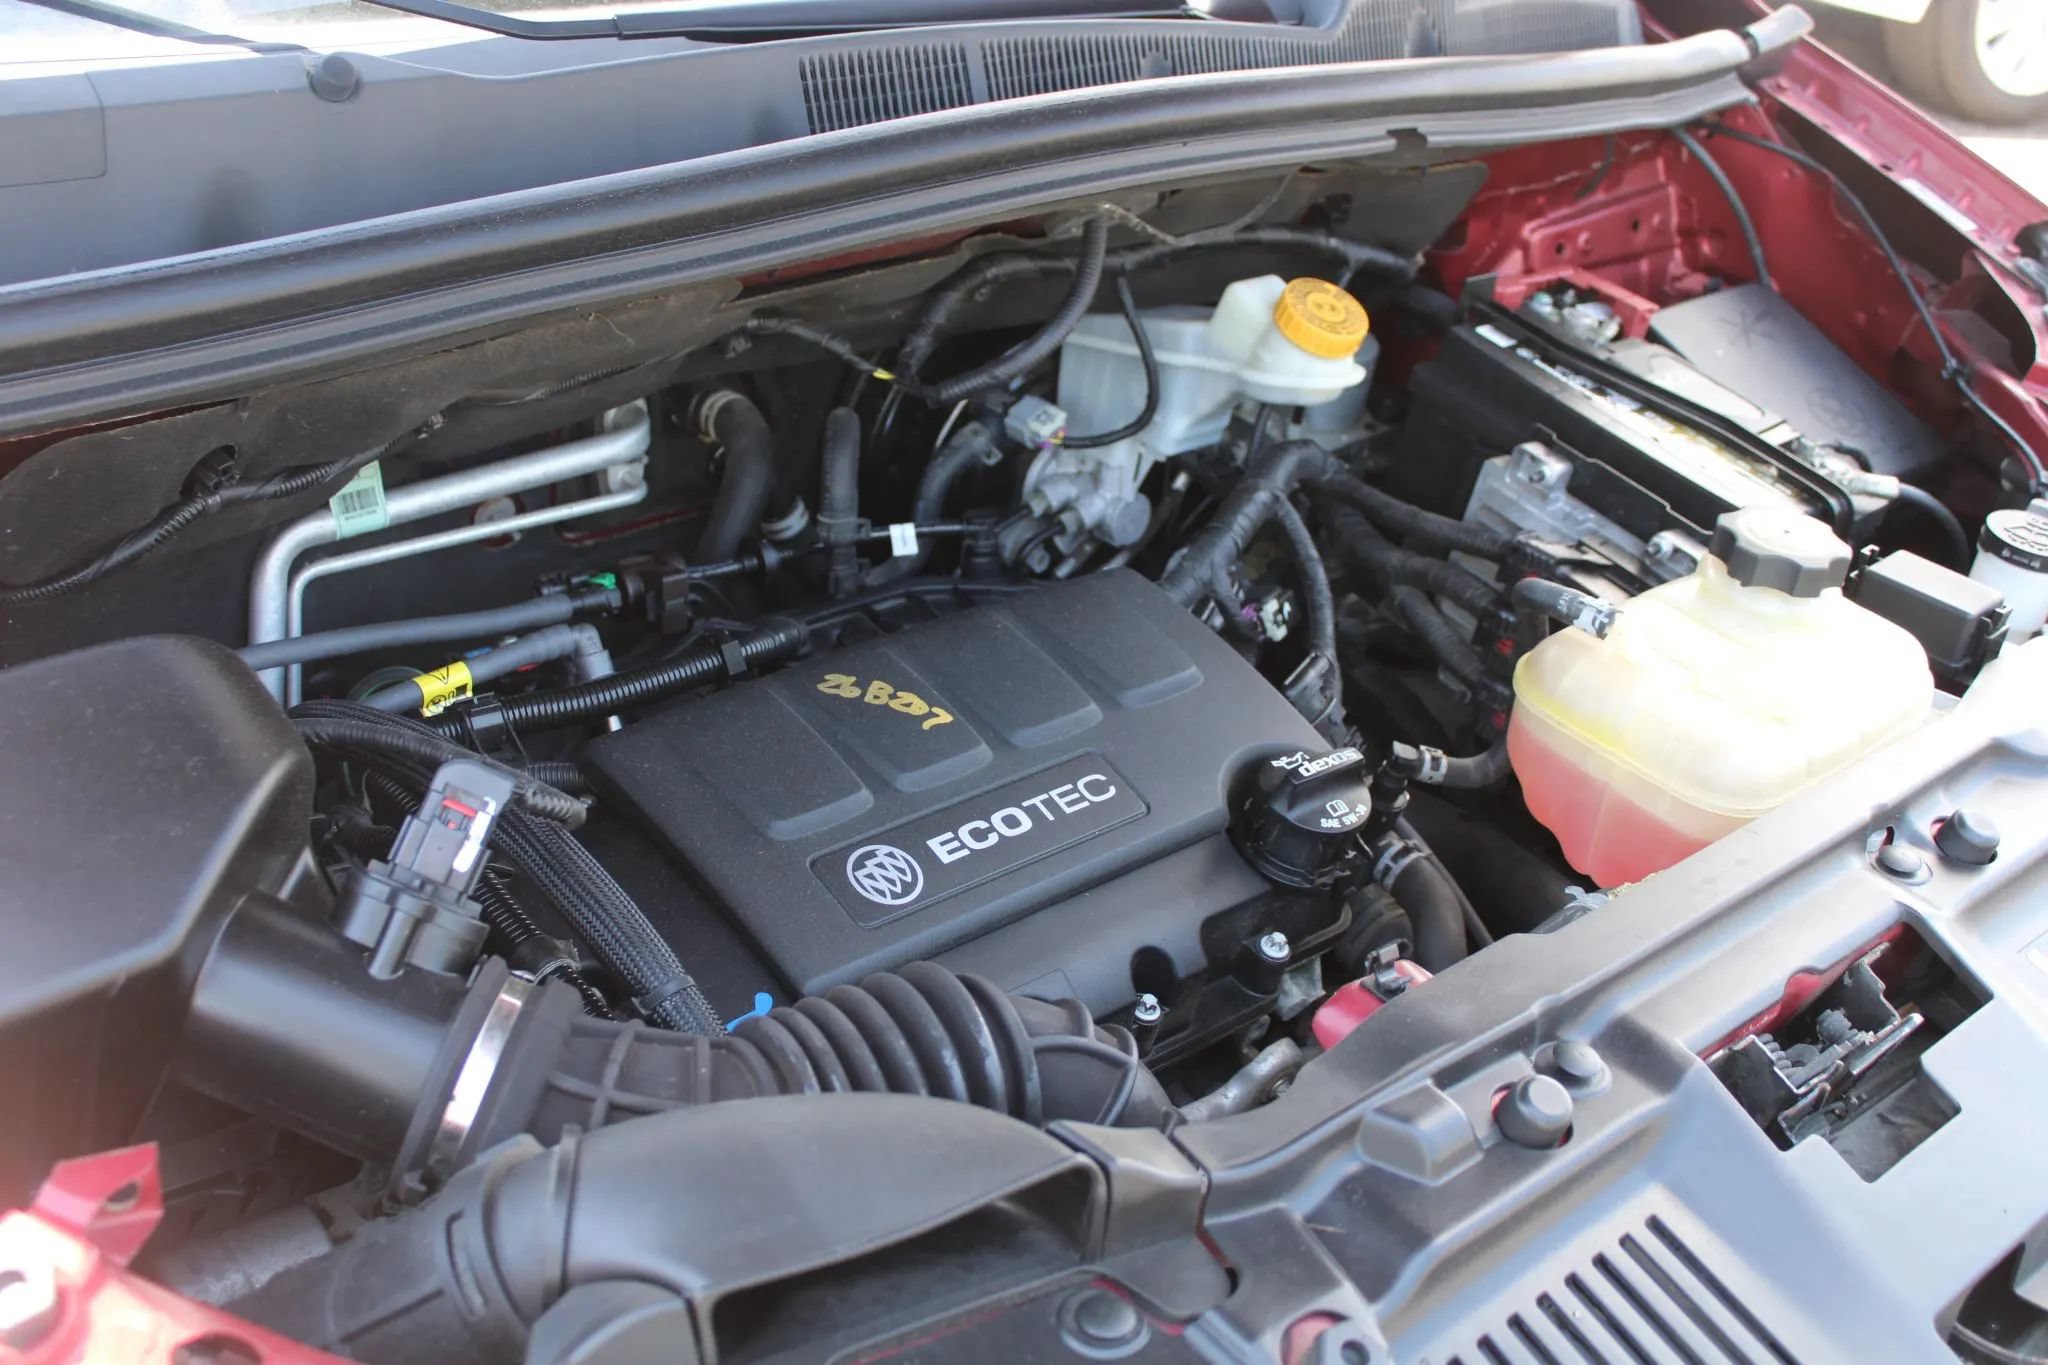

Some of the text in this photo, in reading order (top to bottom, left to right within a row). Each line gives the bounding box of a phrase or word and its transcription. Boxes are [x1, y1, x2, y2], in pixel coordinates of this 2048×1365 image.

[1298, 748, 1358, 777] dexos
[926, 774, 1117, 865] ECOTEC
[1320, 818, 1341, 828] SAE
